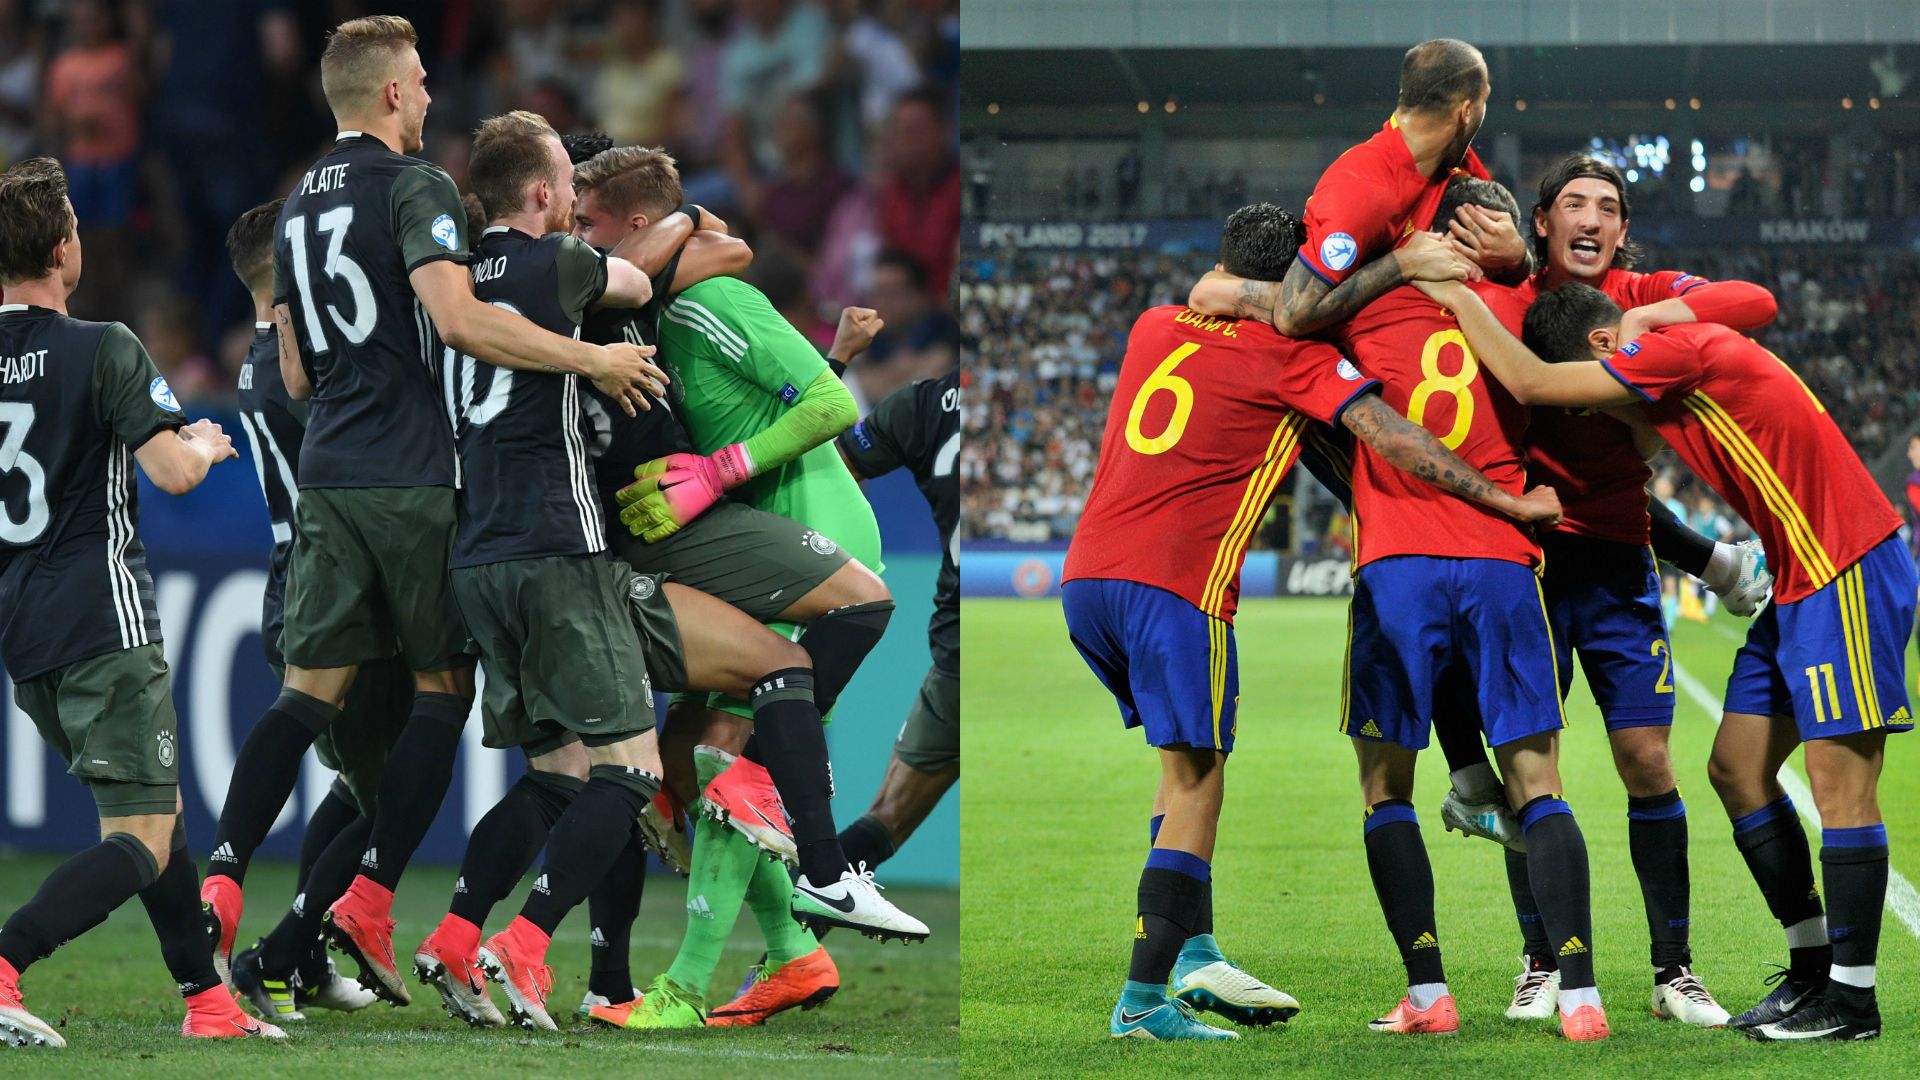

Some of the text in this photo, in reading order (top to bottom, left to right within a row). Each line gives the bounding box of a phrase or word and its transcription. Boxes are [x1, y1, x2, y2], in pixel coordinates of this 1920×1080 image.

[301, 163, 349, 195] PLATTE
[980, 222, 1148, 248] POLAND 2017
[285, 207, 376, 352] 13
[1124, 341, 1201, 455] 6
[1407, 328, 1478, 451] 8
[0, 401, 50, 544] 3
[1287, 559, 1354, 596] UEF
[1651, 639, 1673, 694] 2
[1805, 663, 1842, 722] 11
[210, 854, 239, 864] adidas
[1559, 946, 1588, 957] adidas
